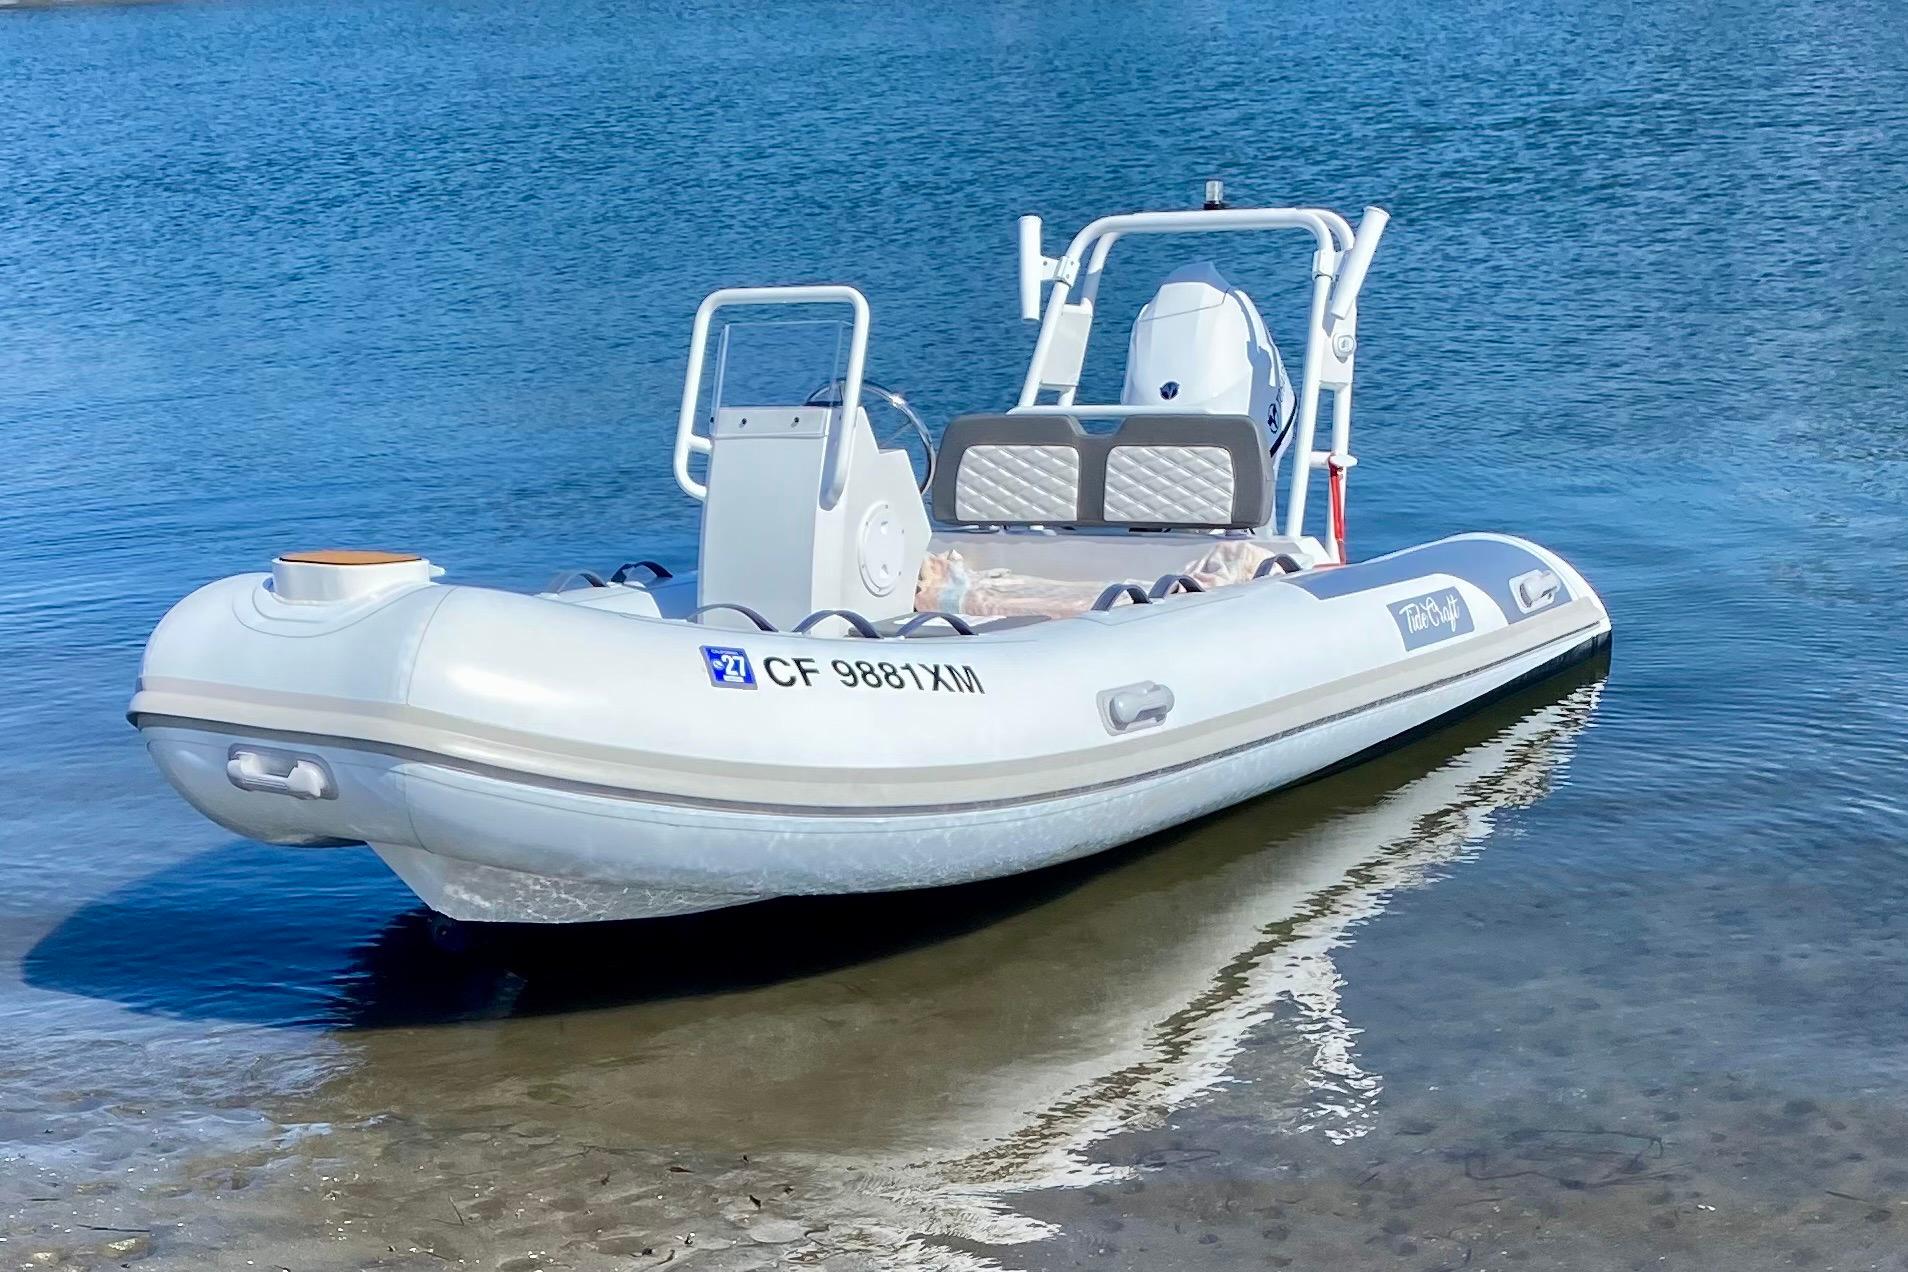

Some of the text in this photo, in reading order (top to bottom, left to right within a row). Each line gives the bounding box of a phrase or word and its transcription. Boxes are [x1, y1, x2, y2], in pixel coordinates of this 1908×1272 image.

[721, 654, 746, 677] 27
[764, 657, 985, 694] CF 9881XM
